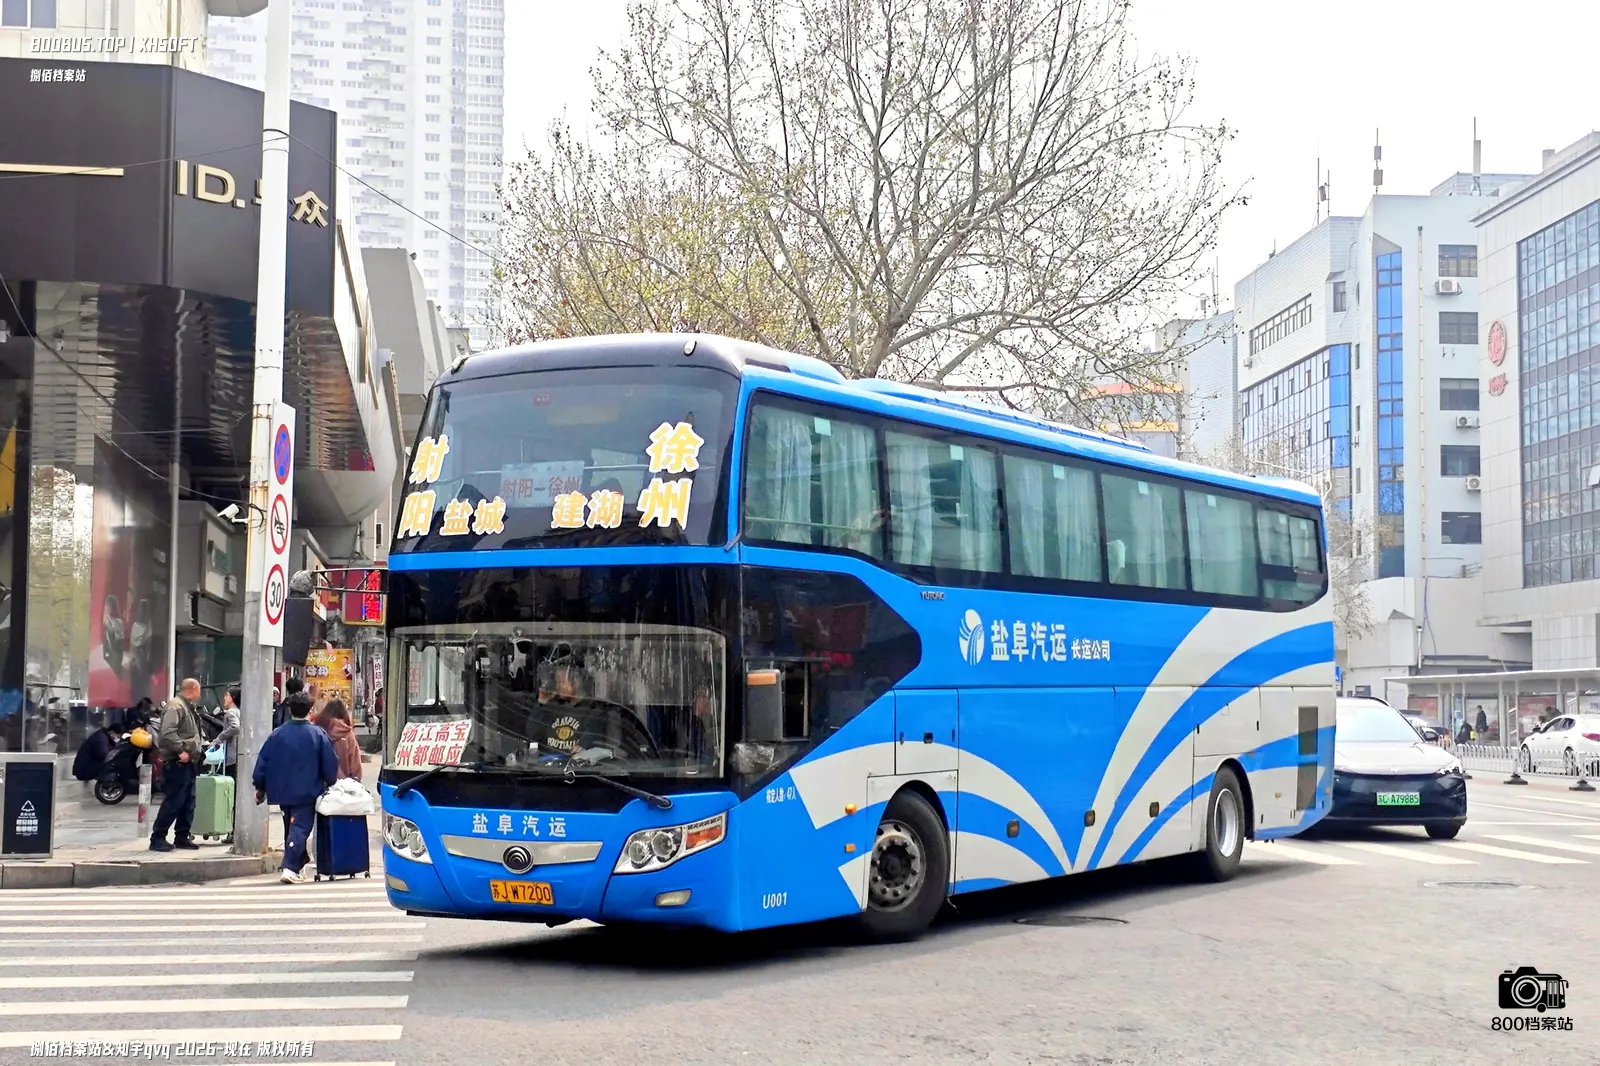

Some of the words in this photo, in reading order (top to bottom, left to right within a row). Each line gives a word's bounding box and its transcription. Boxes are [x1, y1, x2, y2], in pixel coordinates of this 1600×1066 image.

[440, 496, 506, 535] 盐城
[550, 489, 625, 530] 建湖
[269, 581, 281, 608] 30
[991, 620, 1067, 662] 盐阜汽运
[1071, 637, 1111, 662] 长运公司
[472, 813, 566, 837] 盐阜汽运
[762, 891, 788, 909] U001
